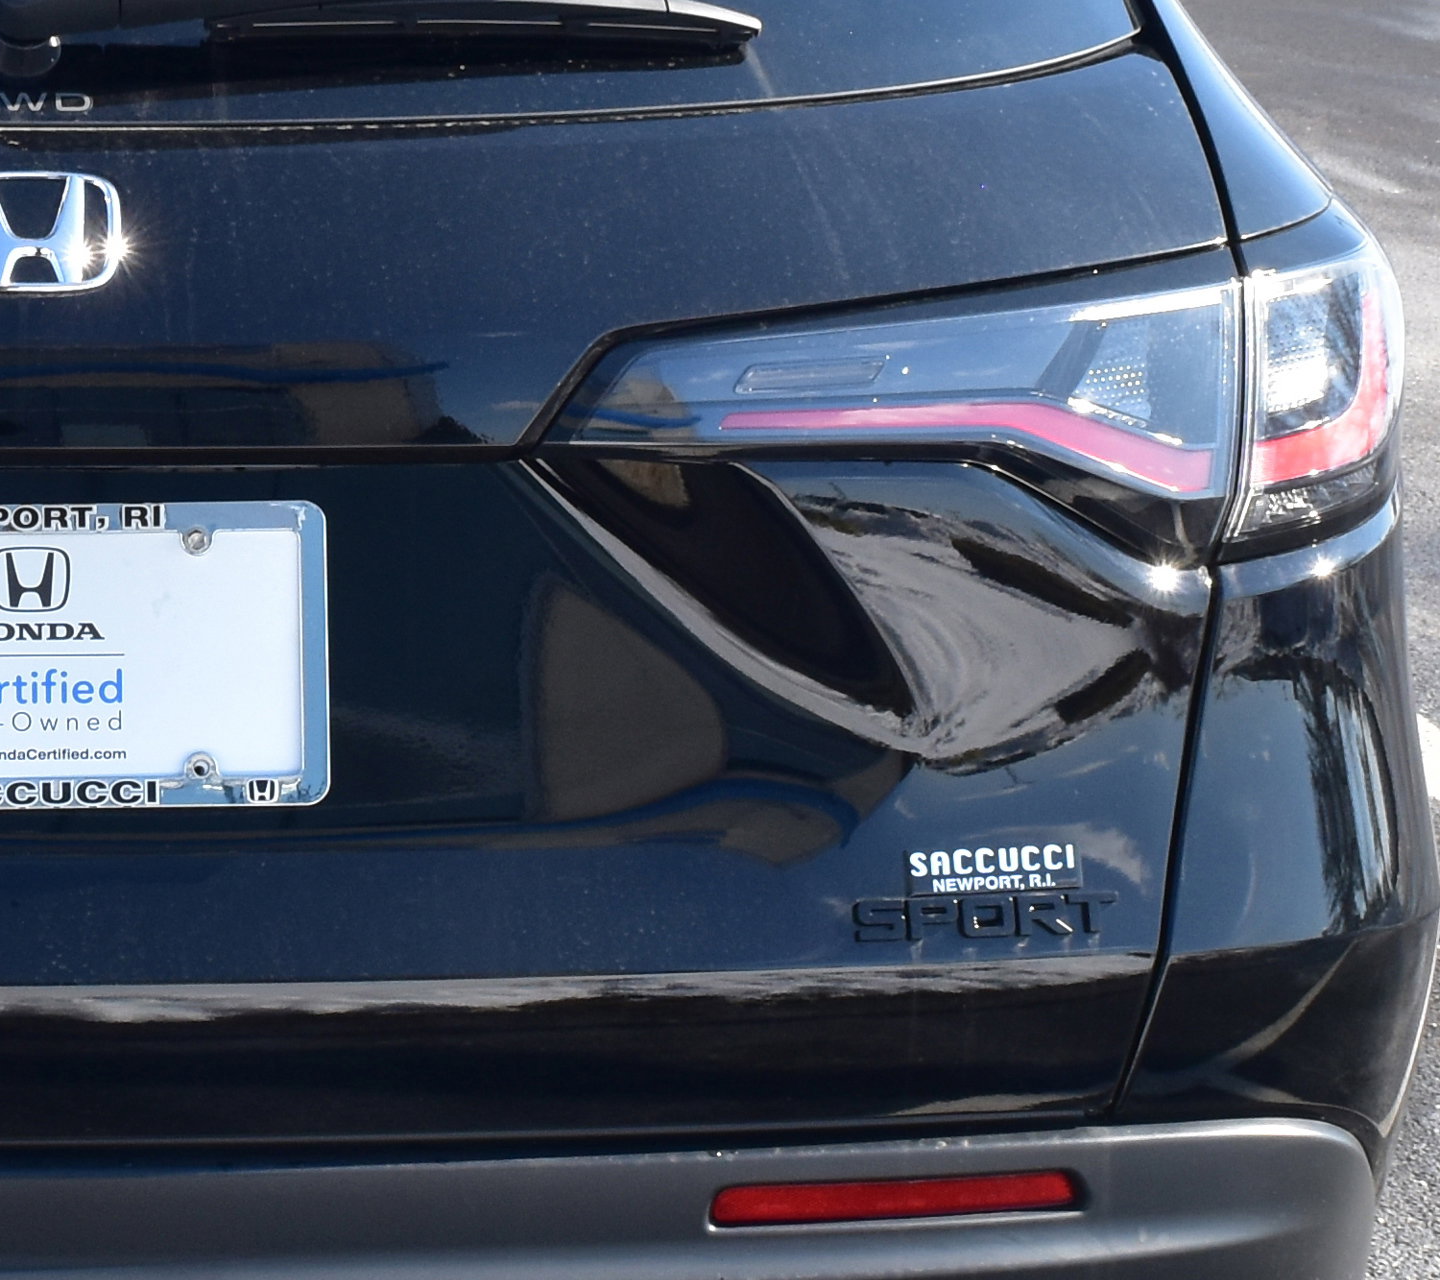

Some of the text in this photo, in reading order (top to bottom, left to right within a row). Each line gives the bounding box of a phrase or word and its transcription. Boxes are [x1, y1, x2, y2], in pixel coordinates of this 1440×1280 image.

[120, 505, 168, 529] RI
[909, 844, 1075, 877] SACCUCCI
[932, 873, 1056, 893] NEWPORT, R.I.
[852, 891, 1119, 942] SPORT
